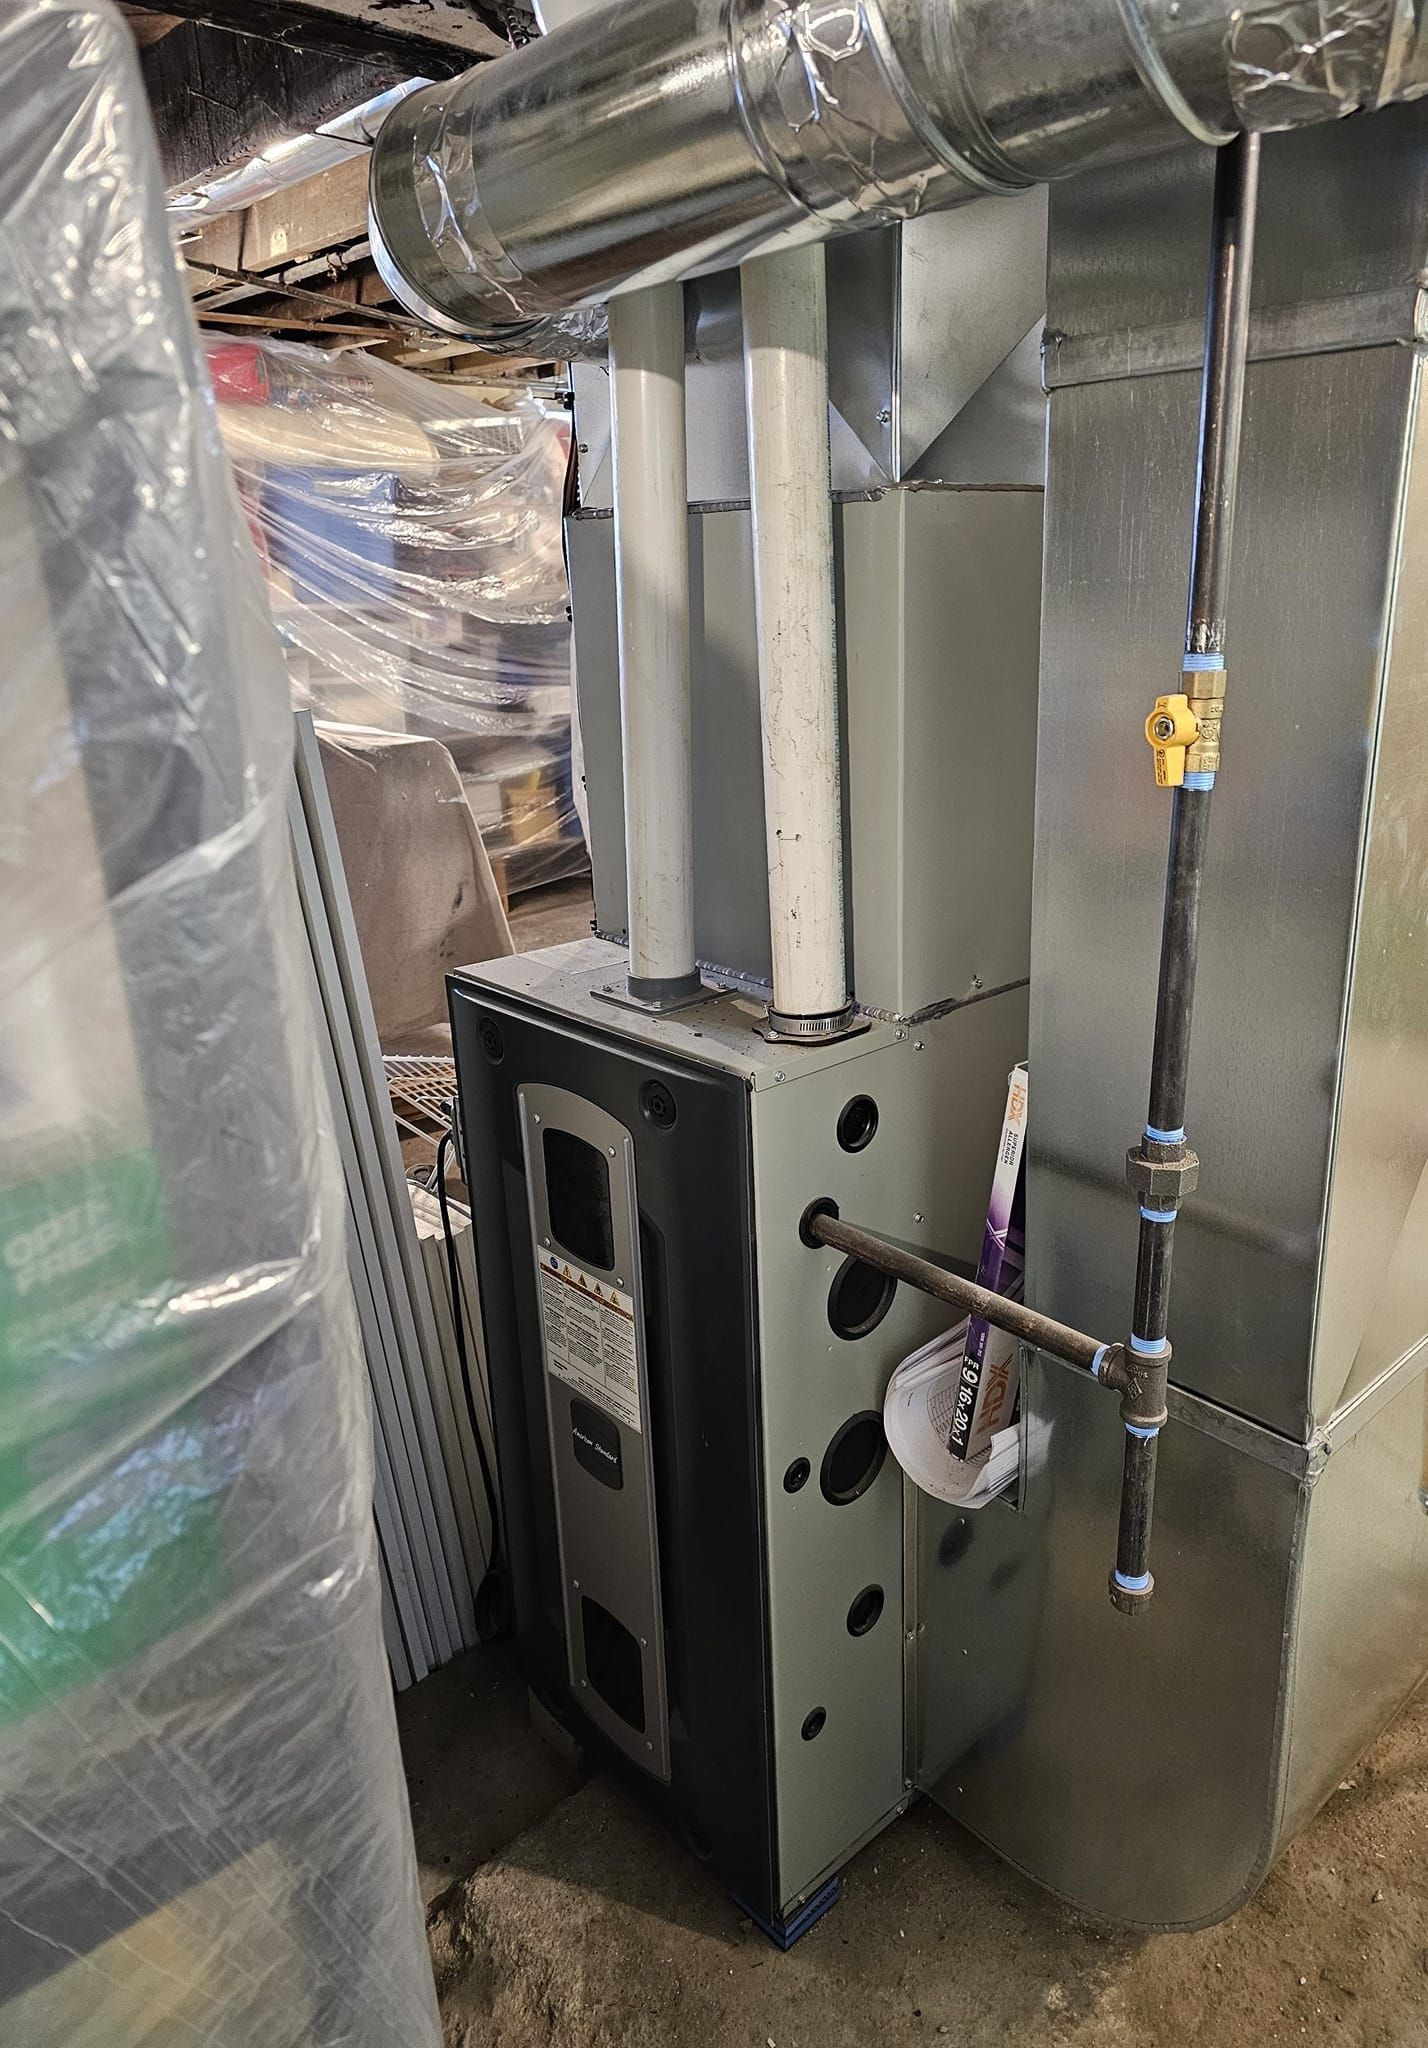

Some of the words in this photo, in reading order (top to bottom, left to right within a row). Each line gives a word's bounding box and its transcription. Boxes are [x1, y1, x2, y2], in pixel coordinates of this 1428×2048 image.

[1007, 1083, 1027, 1127] HDX
[1003, 1130, 1013, 1165] ALLERGEN
[1008, 1133, 1019, 1166] SUPERIOR
[962, 1367, 979, 1384] 9
[964, 1355, 979, 1371] FPR
[976, 1352, 1014, 1436] HDX
